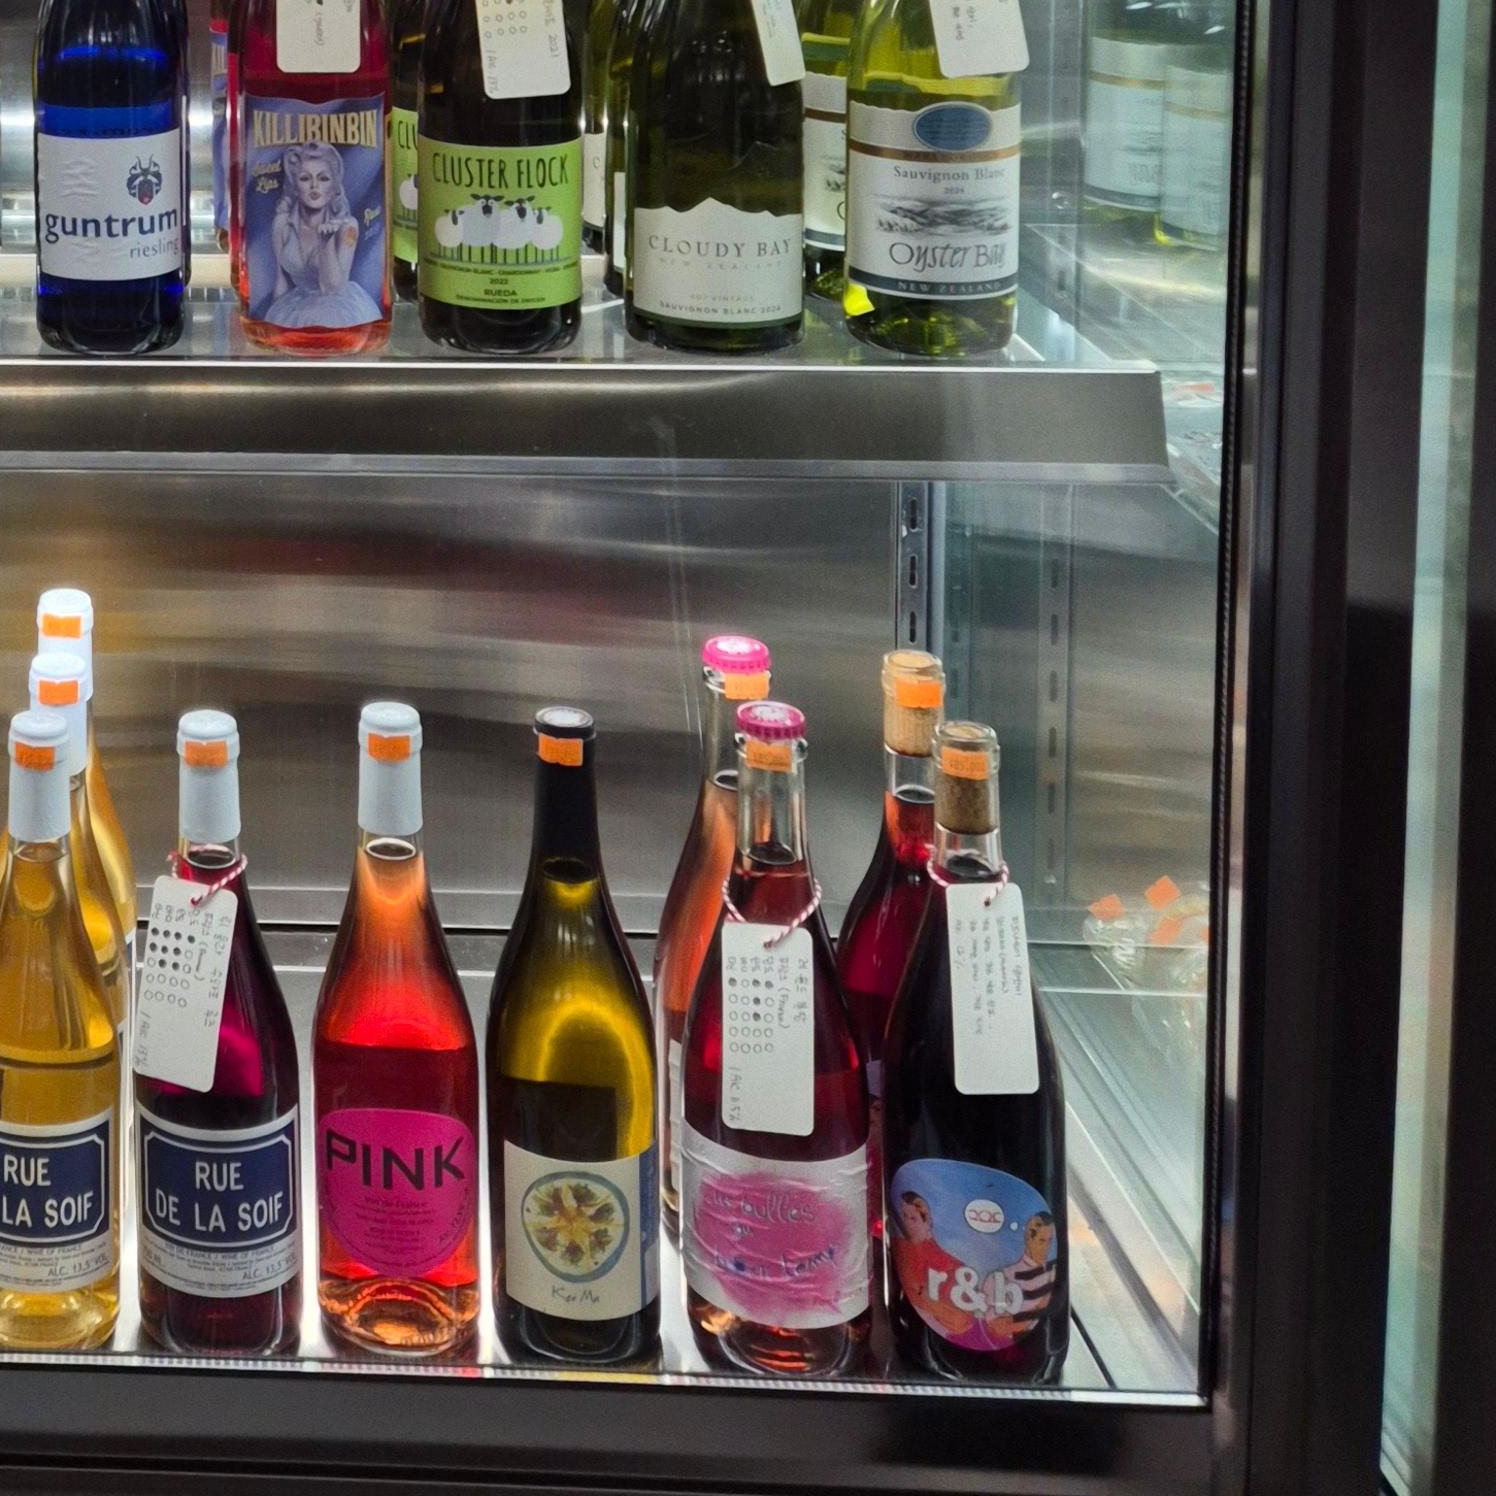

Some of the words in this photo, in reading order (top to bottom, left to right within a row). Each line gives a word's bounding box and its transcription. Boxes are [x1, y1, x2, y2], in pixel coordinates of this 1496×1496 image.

[253, 108, 379, 148] KILLIBINBIN
[432, 151, 510, 191] CLUSTER
[516, 152, 569, 189] FLOCK
[893, 165, 971, 183] Sauvignon
[974, 166, 1008, 180] Blanc
[44, 207, 179, 245] guntrum
[129, 235, 180, 260] riesling
[648, 234, 747, 259] CLOUDY
[757, 238, 792, 258] BAY
[888, 240, 973, 273] Oyster
[483, 287, 518, 298] RUEDA
[896, 281, 931, 293] NEW
[938, 281, 1002, 293] ZEALAND
[660, 300, 719, 315] SAUVIGNON
[722, 305, 757, 315] BLANC
[3, 1153, 52, 1188] RUE
[194, 1160, 245, 1193] RUE
[325, 1127, 466, 1192] PINK
[1, 1194, 33, 1229] LA
[43, 1189, 94, 1229] SOIF
[155, 1187, 182, 1226] DE
[194, 1202, 227, 1234] LA
[237, 1190, 285, 1232] SOIF
[927, 1265, 1025, 1315] r&b
